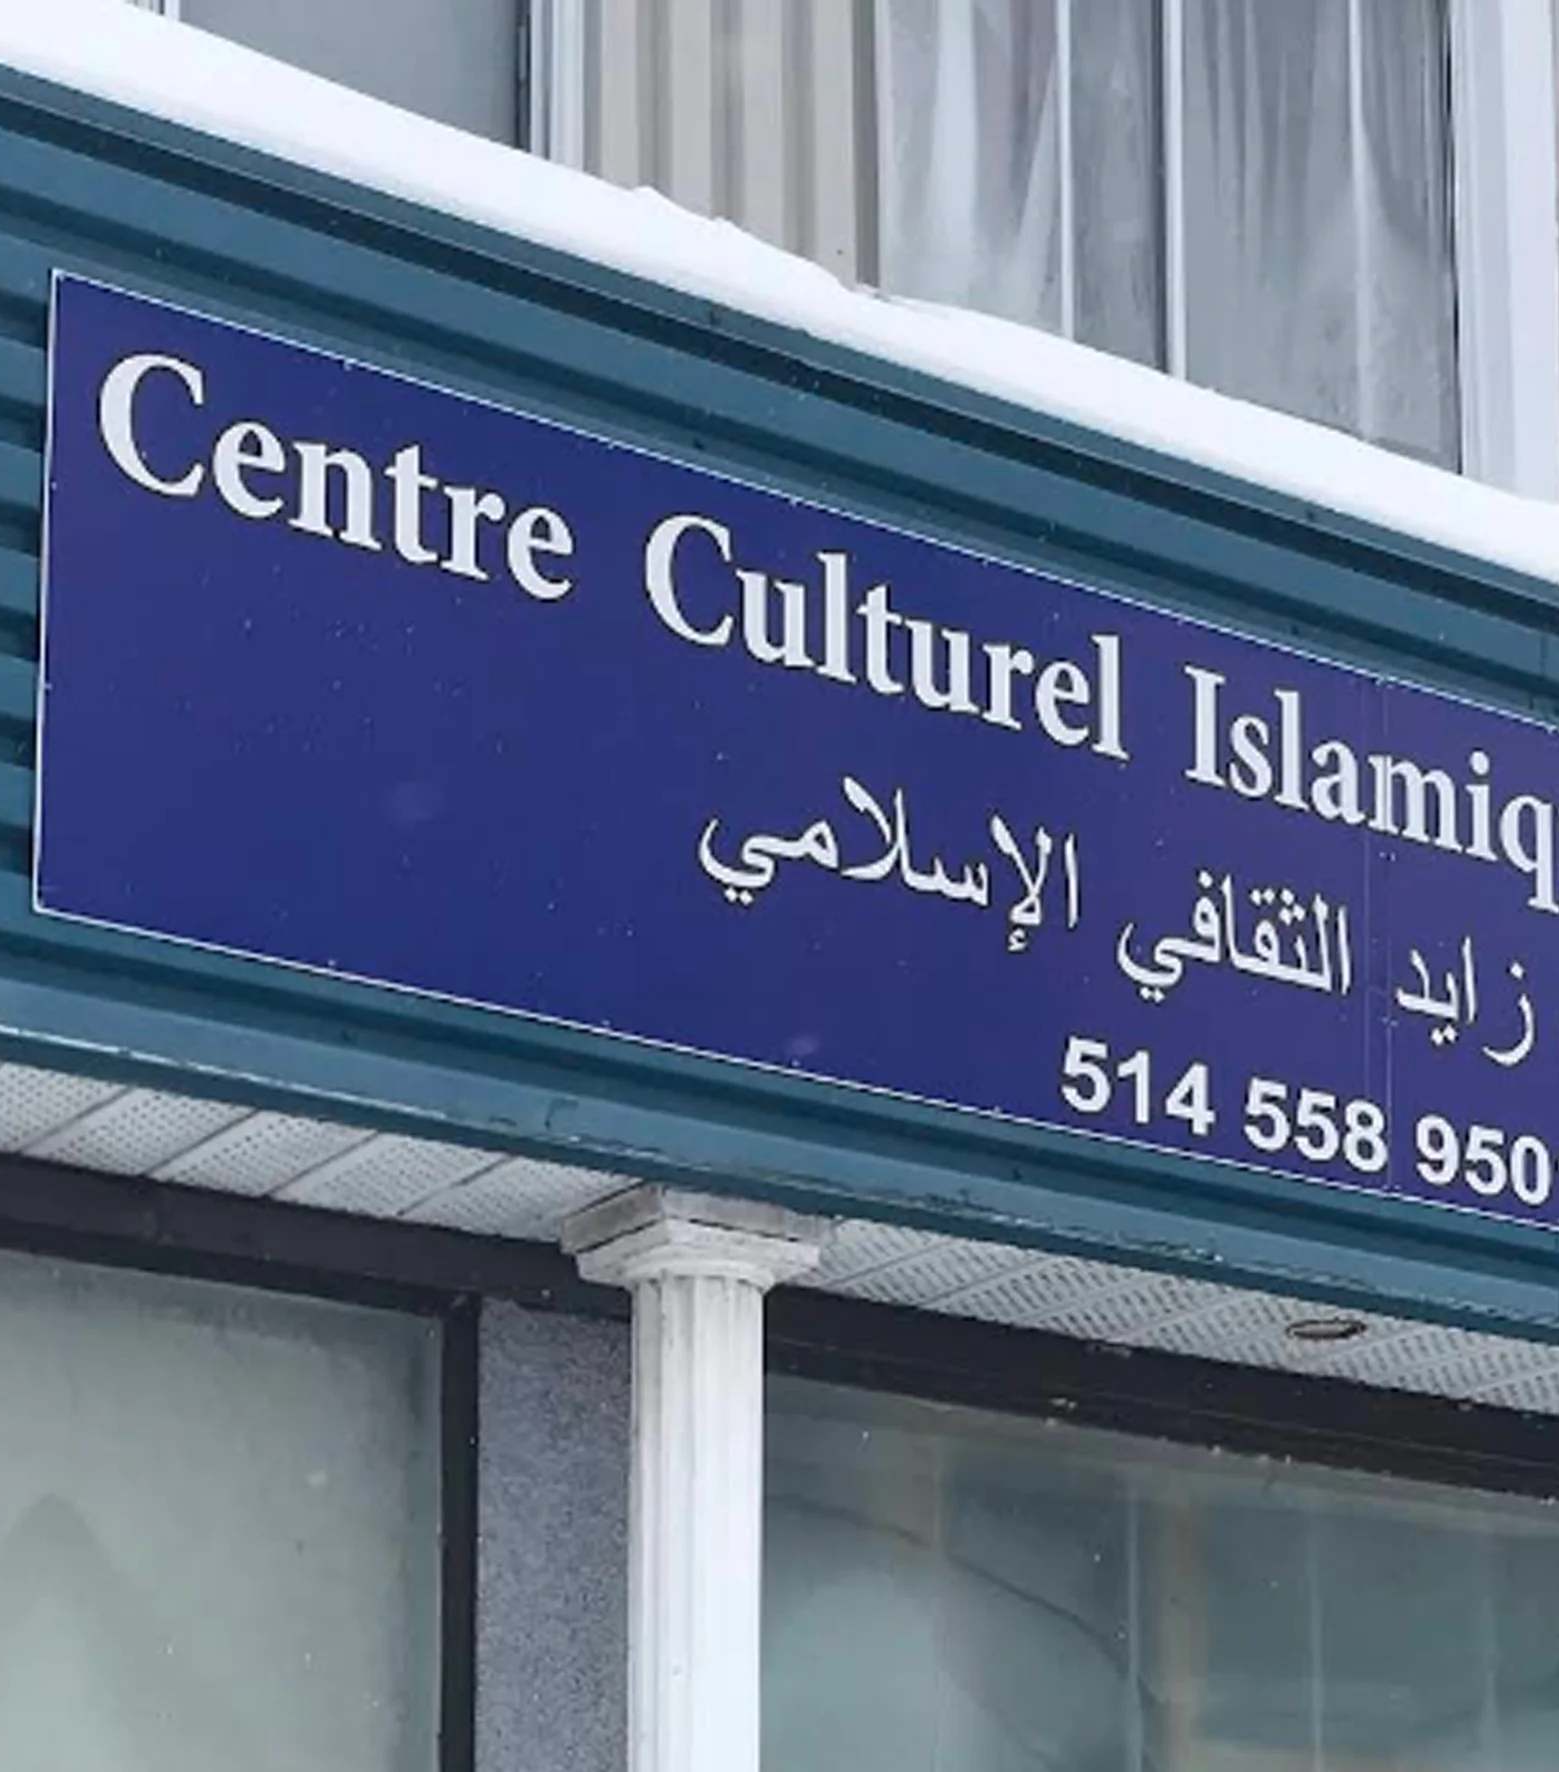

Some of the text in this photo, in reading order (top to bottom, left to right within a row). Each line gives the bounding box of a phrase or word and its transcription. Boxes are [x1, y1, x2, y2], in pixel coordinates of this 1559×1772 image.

[97, 352, 576, 602] Centre
[643, 514, 1131, 762] Culturel
[697, 775, 1079, 952] الإسلامي
[1116, 870, 1352, 1004] الثقافي
[1394, 935, 1536, 1067] زايد
[1060, 1035, 1217, 1135] 514
[1242, 1076, 1390, 1172] 558
